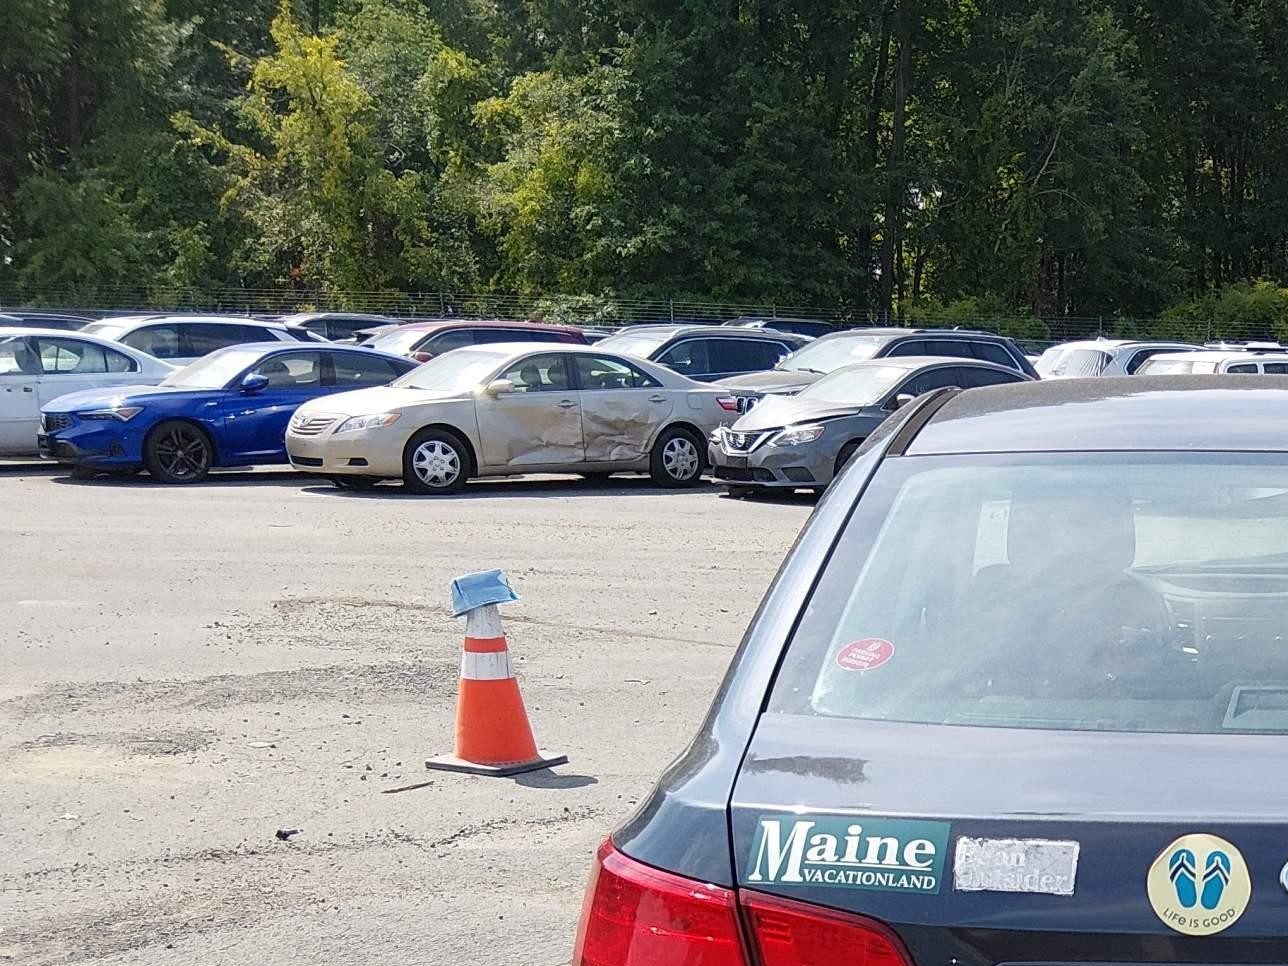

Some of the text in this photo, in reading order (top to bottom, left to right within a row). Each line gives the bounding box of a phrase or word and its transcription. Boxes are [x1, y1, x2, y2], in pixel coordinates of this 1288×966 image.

[749, 820, 936, 883] Maine
[804, 868, 937, 890] VACATIONLAND
[1189, 918, 1199, 928] IS
[1202, 908, 1235, 928] GOOD
